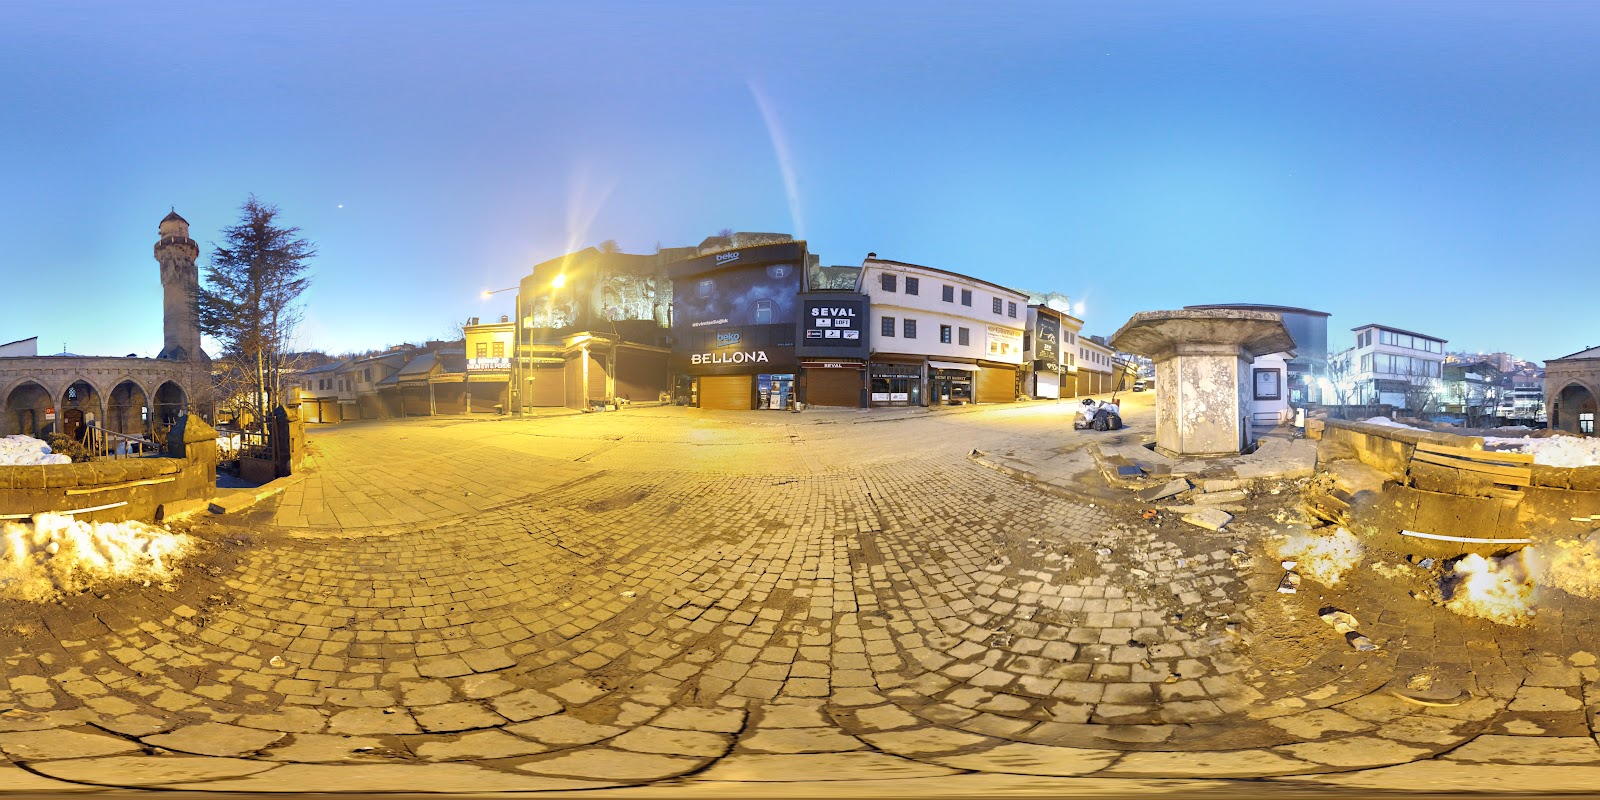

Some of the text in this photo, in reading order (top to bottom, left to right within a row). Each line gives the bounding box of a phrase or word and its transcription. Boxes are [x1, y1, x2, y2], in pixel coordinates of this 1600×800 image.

[716, 252, 739, 261] beko
[811, 307, 855, 316] SEVAL
[717, 333, 739, 341] beko
[691, 351, 769, 364] BELLONA
